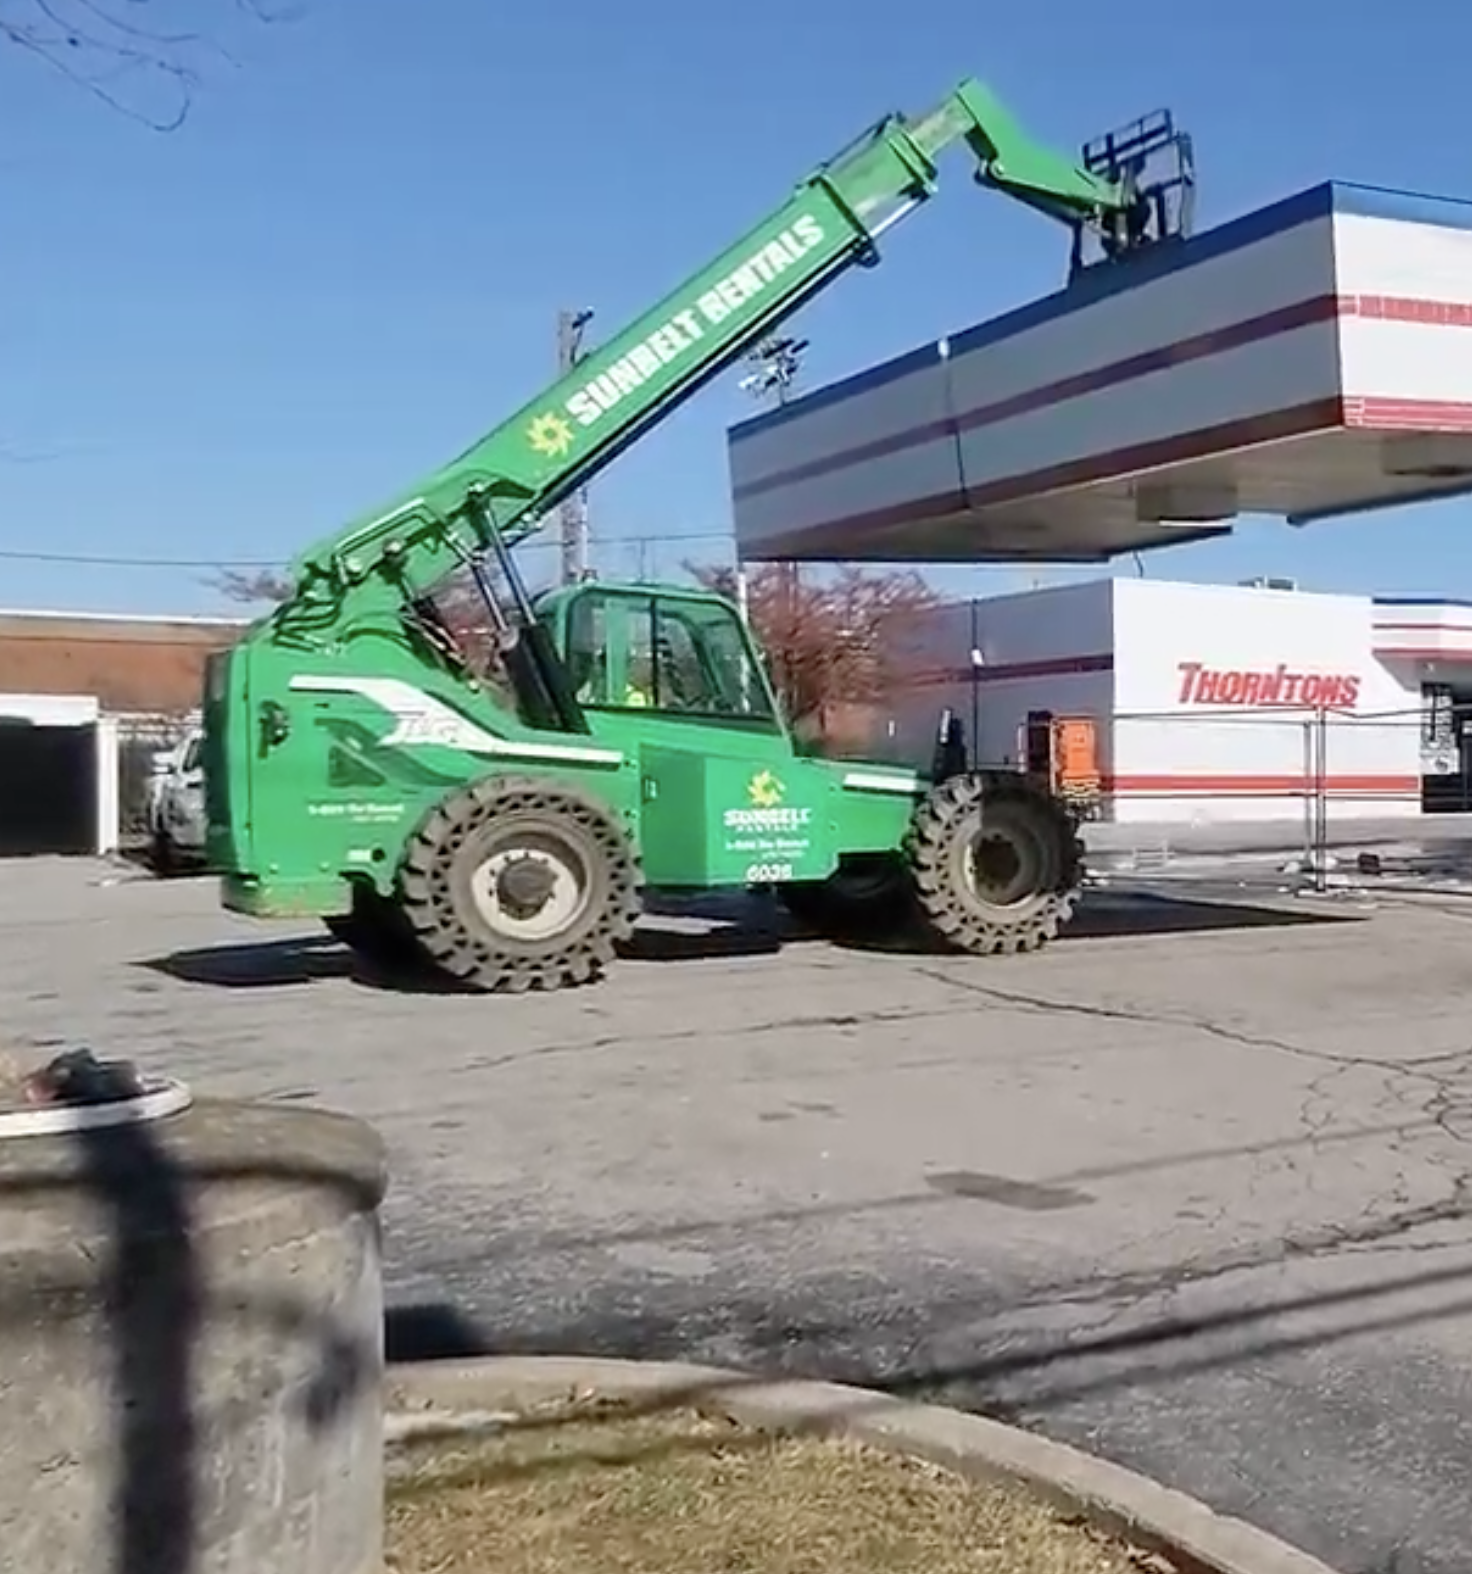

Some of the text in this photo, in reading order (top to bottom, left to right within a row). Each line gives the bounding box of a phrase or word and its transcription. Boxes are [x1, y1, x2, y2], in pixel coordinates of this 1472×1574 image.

[564, 213, 825, 426] SUNBELT RENTALS
[1178, 662, 1361, 708] THORNTONS
